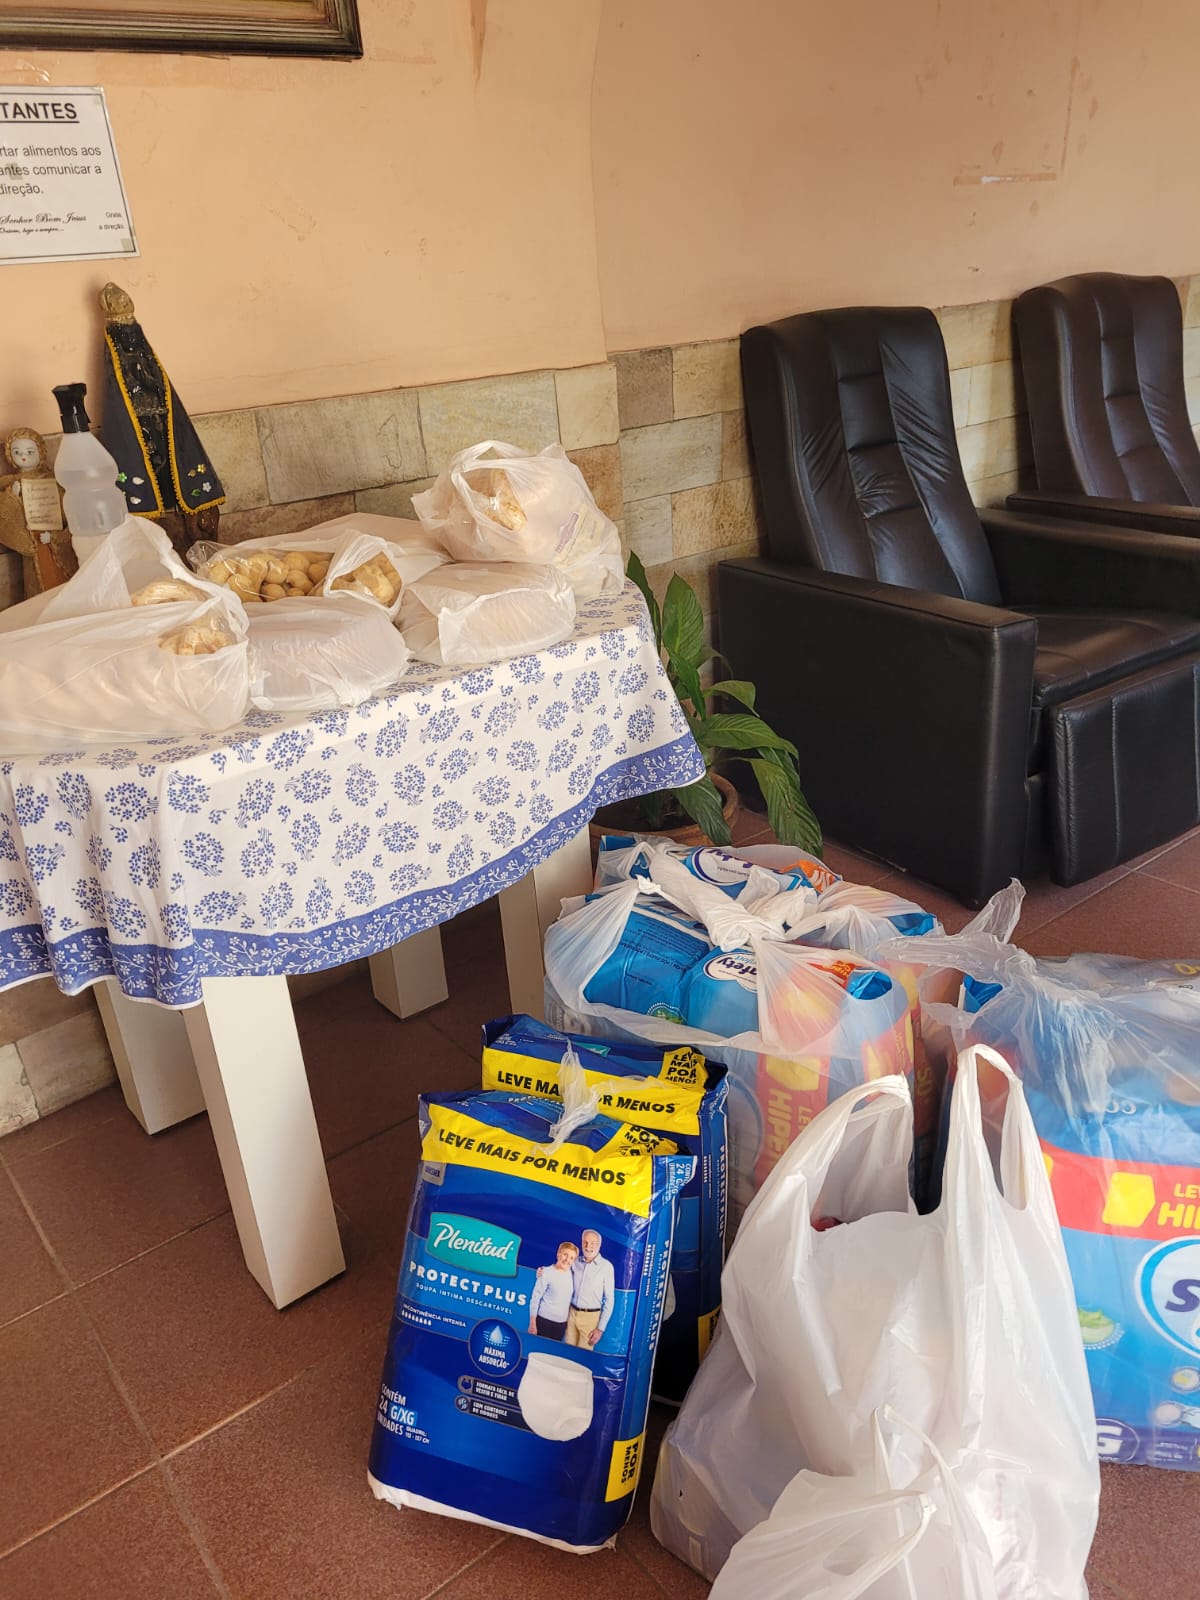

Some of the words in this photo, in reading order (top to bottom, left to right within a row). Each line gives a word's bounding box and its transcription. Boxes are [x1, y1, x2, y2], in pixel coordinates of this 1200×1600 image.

[23, 144, 78, 157] alimentos
[81, 147, 102, 156] aos
[33, 163, 91, 176] comunicar
[95, 165, 102, 174] a
[716, 957, 757, 975] afety
[497, 1071, 532, 1090] LEVE
[535, 1080, 561, 1097] MA
[616, 1096, 676, 1114] MENOS
[767, 1088, 793, 1160] HIPE
[439, 1128, 476, 1151] LEVE
[477, 1142, 521, 1162] MAIS
[522, 1156, 559, 1173] POR
[562, 1163, 626, 1186] MENOS
[433, 1222, 514, 1260] Plenitud
[409, 1261, 481, 1293] PROTECT
[484, 1284, 528, 1306] PLUS
[381, 1383, 407, 1406] CONTÉM
[390, 1405, 415, 1426] G/XG
[628, 1441, 639, 1480] POR
